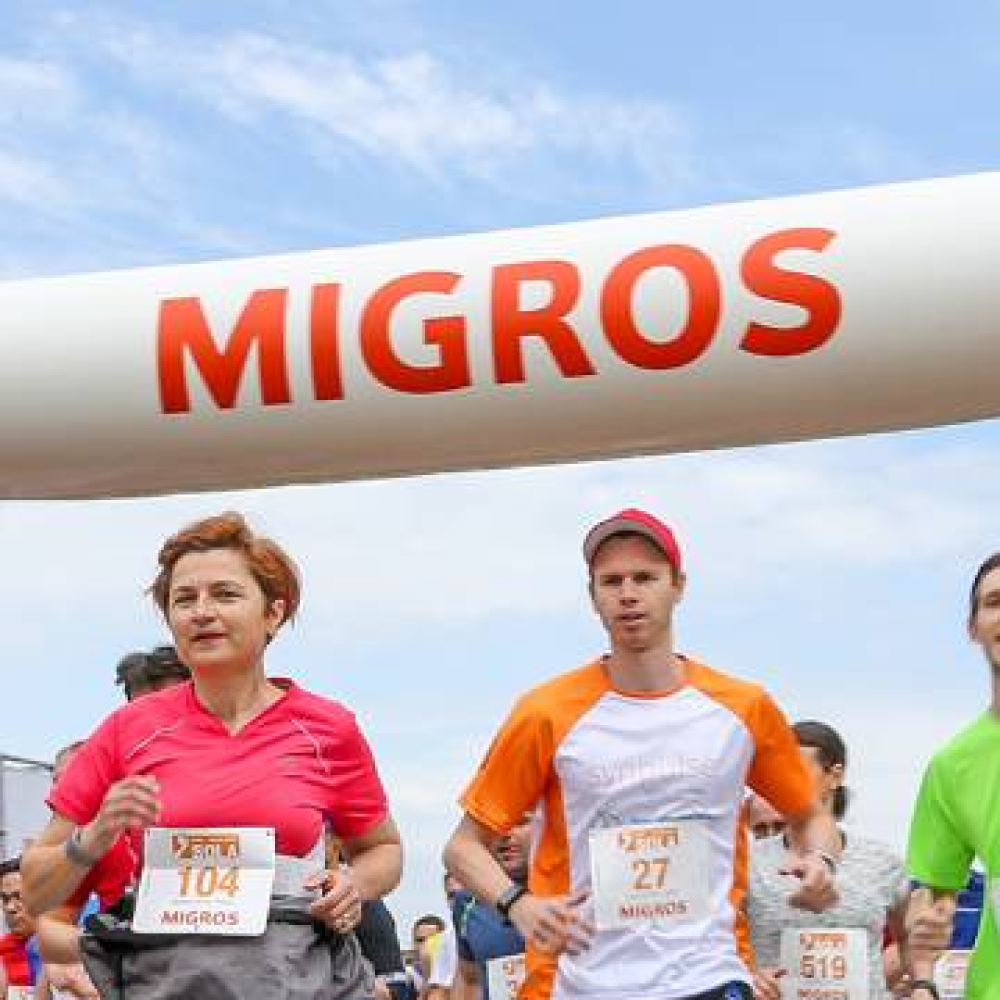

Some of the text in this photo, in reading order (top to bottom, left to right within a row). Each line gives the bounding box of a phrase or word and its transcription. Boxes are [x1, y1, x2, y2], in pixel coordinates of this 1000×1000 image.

[157, 227, 843, 415] MIGROS
[178, 866, 239, 897] 104
[632, 858, 670, 889] 27
[160, 911, 239, 925] MIGROS
[619, 900, 687, 918] MIGROS
